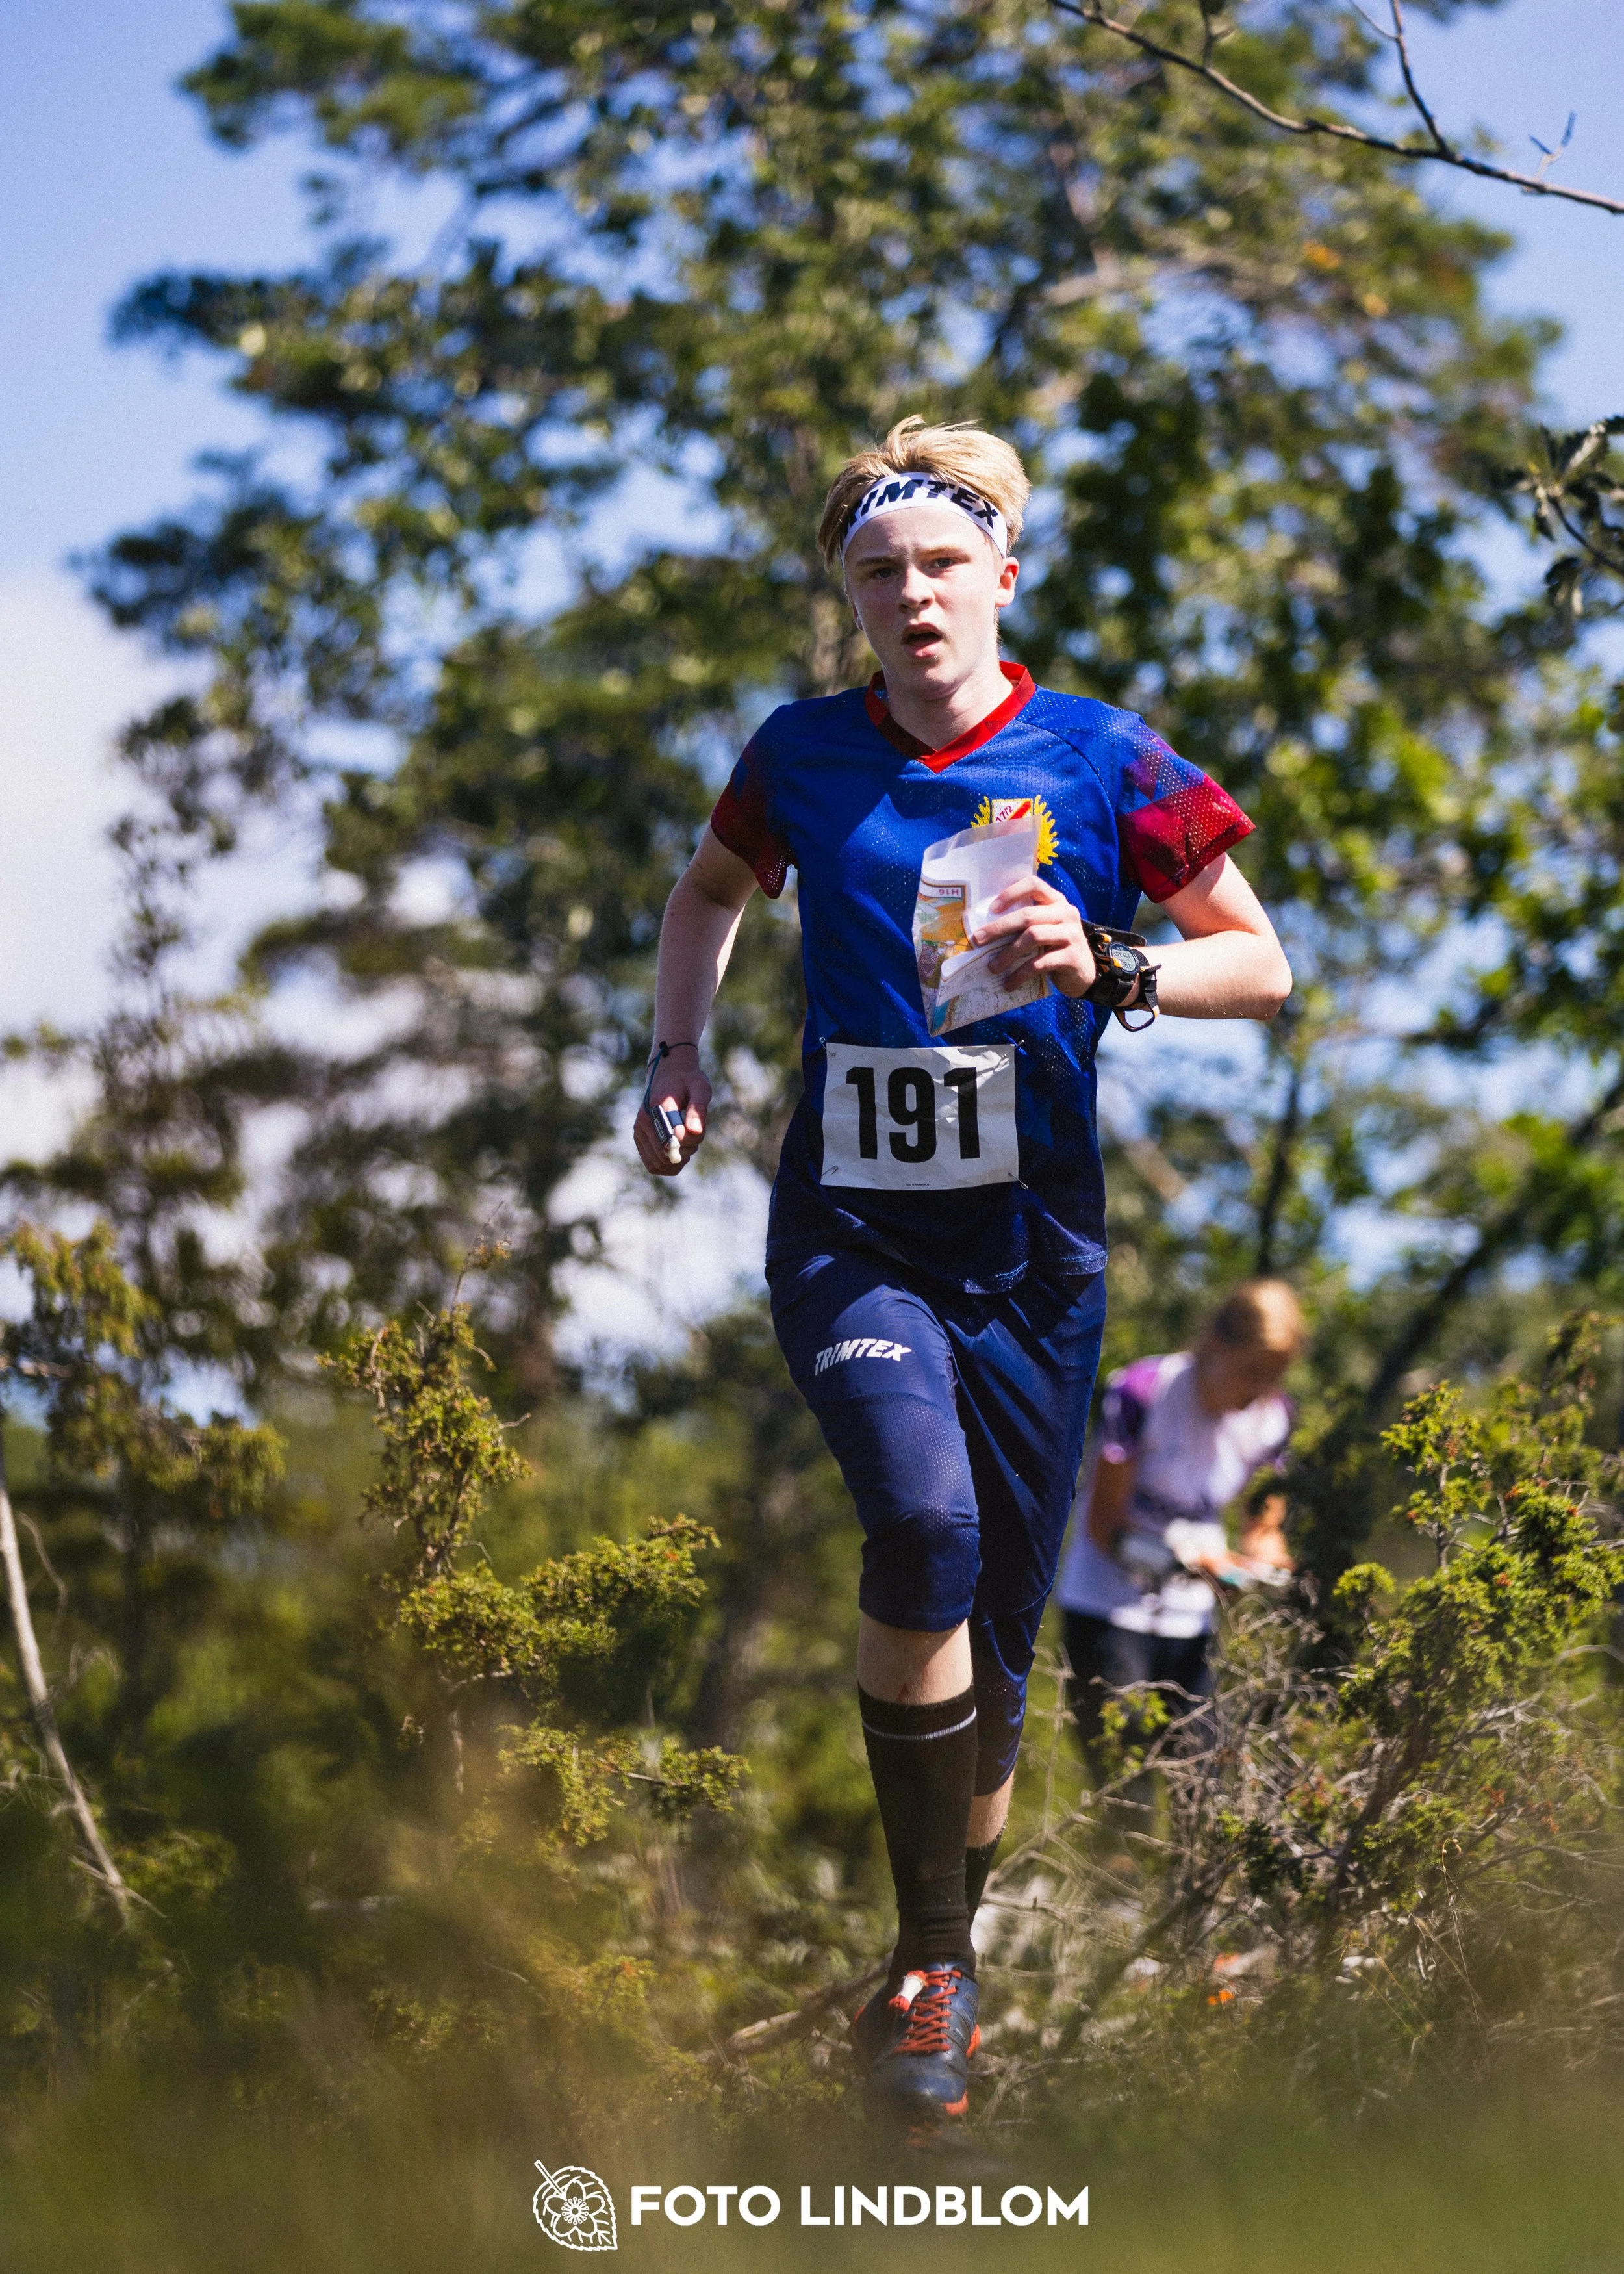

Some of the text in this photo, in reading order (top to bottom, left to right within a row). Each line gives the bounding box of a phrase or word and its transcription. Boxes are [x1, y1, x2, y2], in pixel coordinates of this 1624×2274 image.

[849, 479, 998, 529] IMTEX
[846, 1066, 980, 1163] 191
[815, 1338, 912, 1376] TRIMTEX
